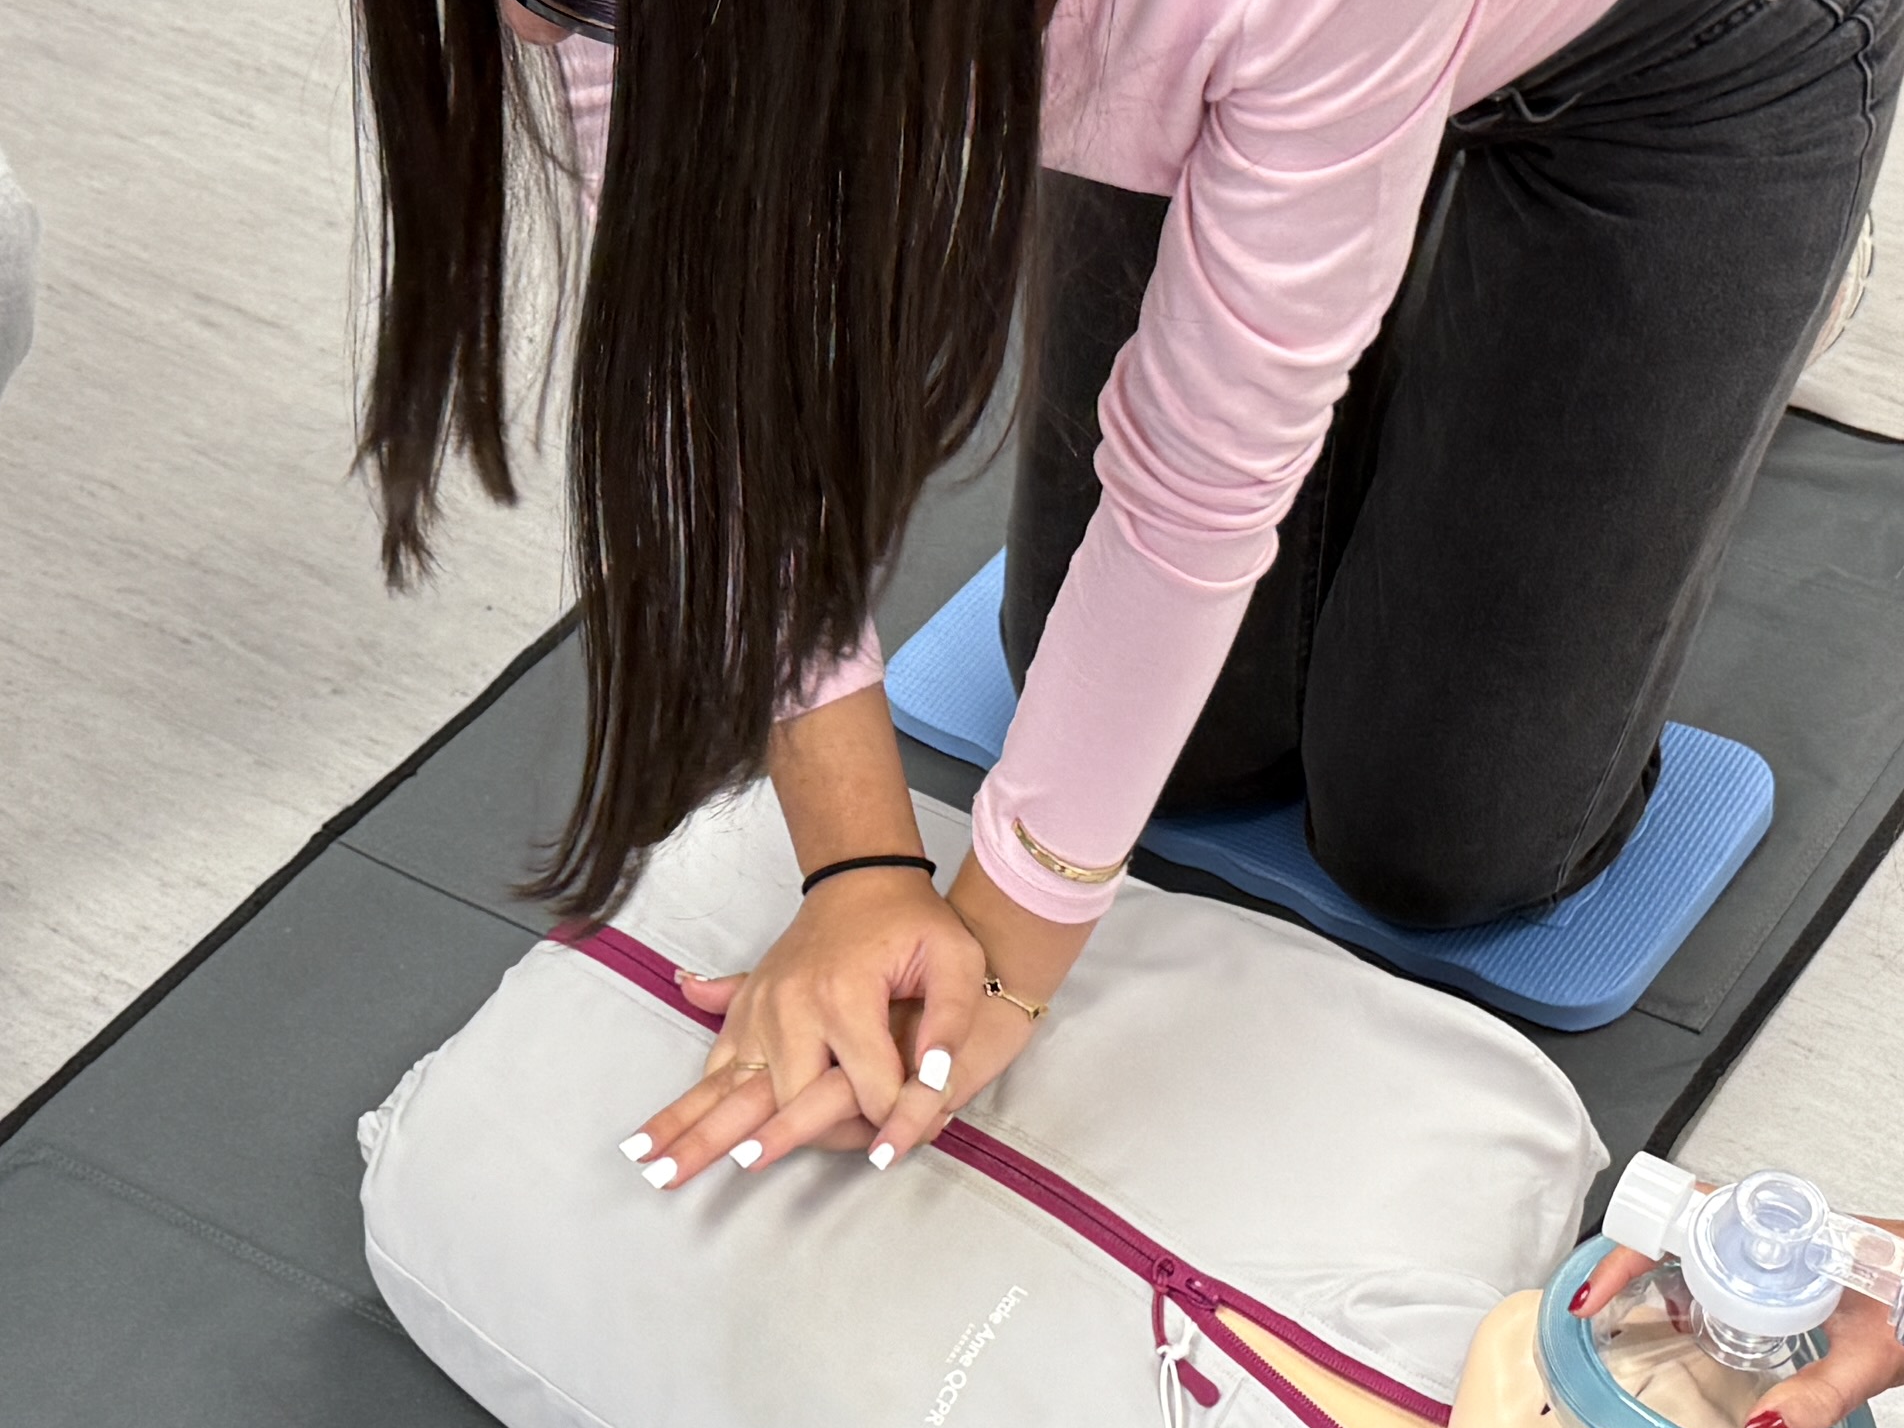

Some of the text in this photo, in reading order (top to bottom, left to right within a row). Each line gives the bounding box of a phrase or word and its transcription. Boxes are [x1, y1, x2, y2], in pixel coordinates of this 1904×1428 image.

[924, 1284, 1029, 1427] Little Anne QCPR
